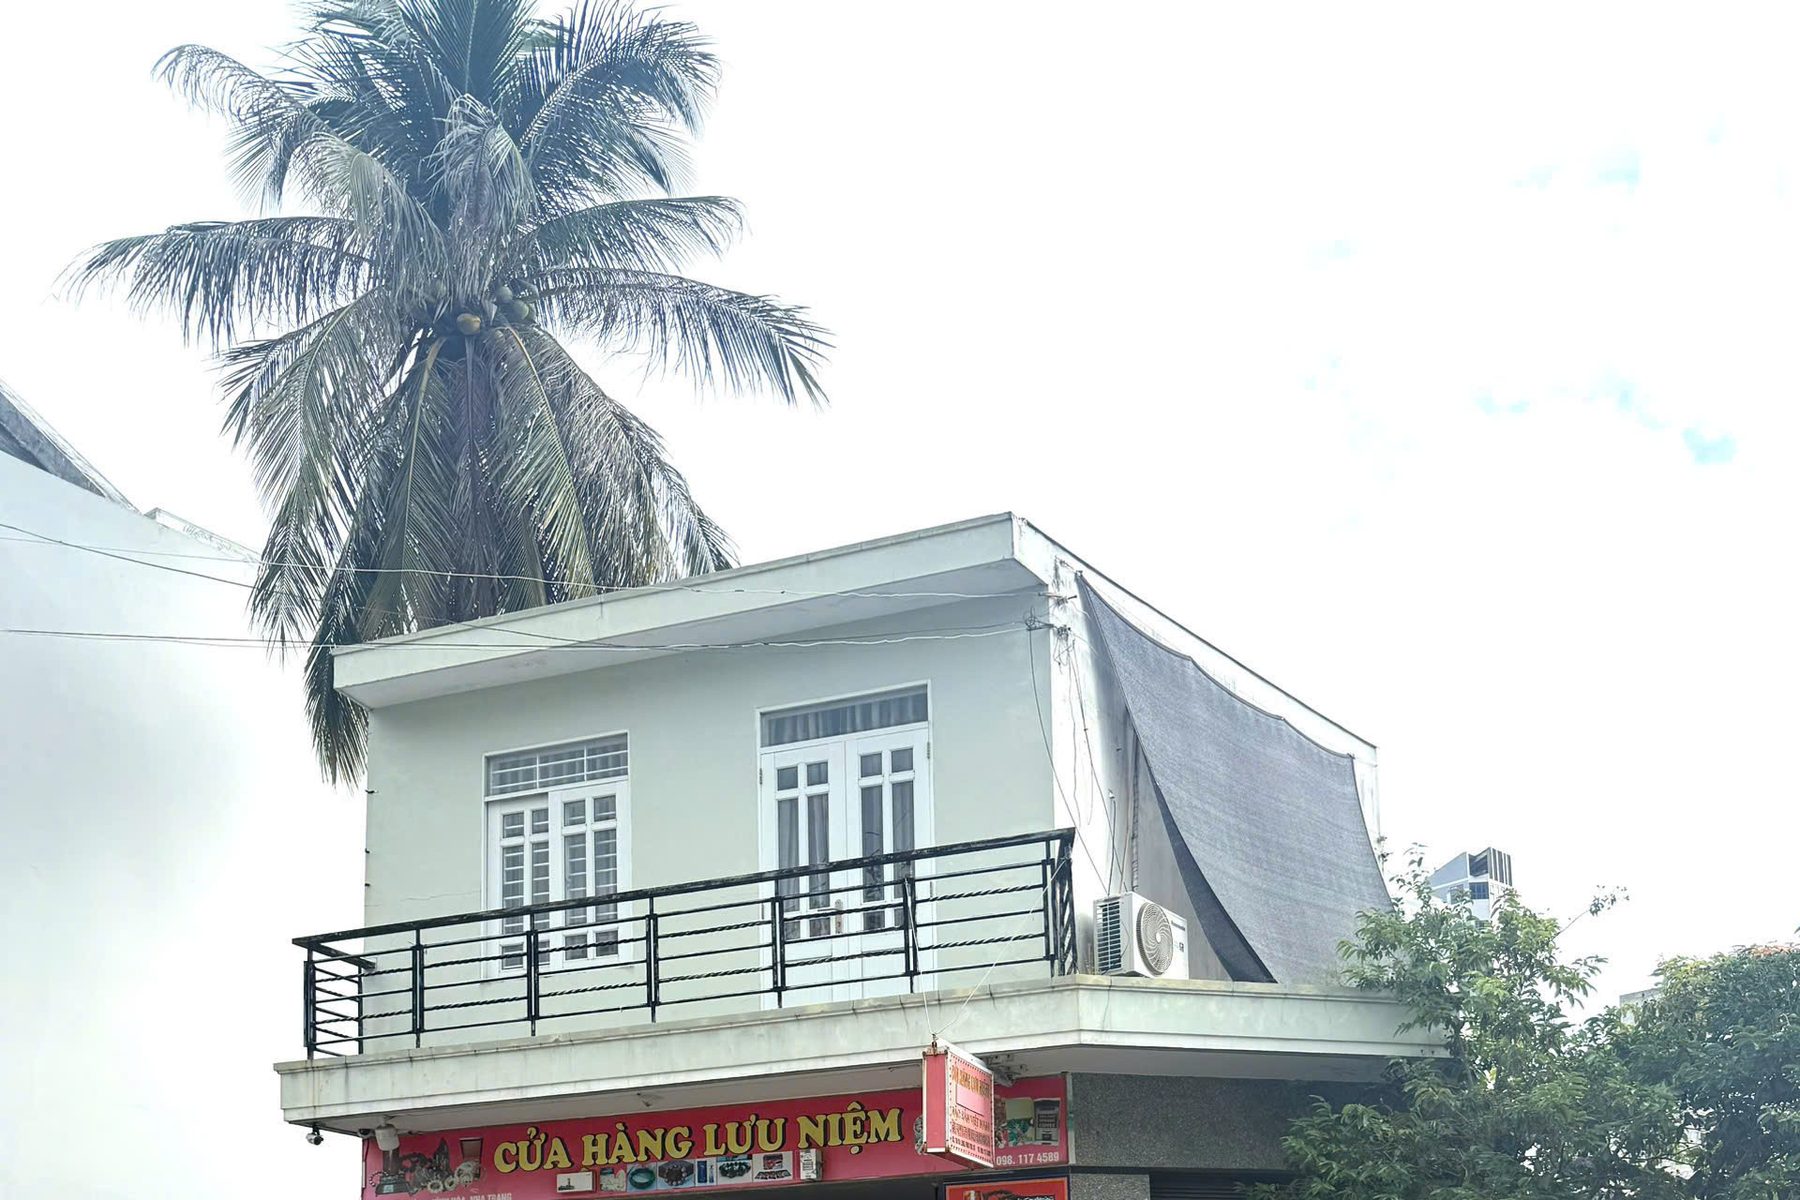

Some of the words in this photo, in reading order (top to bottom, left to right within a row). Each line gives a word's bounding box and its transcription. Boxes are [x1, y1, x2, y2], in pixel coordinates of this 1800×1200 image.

[494, 1126, 572, 1174] CỬA
[581, 1122, 694, 1166] HÀNG
[702, 1116, 787, 1157] LƯU
[798, 1102, 903, 1155] NIỆM
[1018, 1153, 1035, 1164] 117
